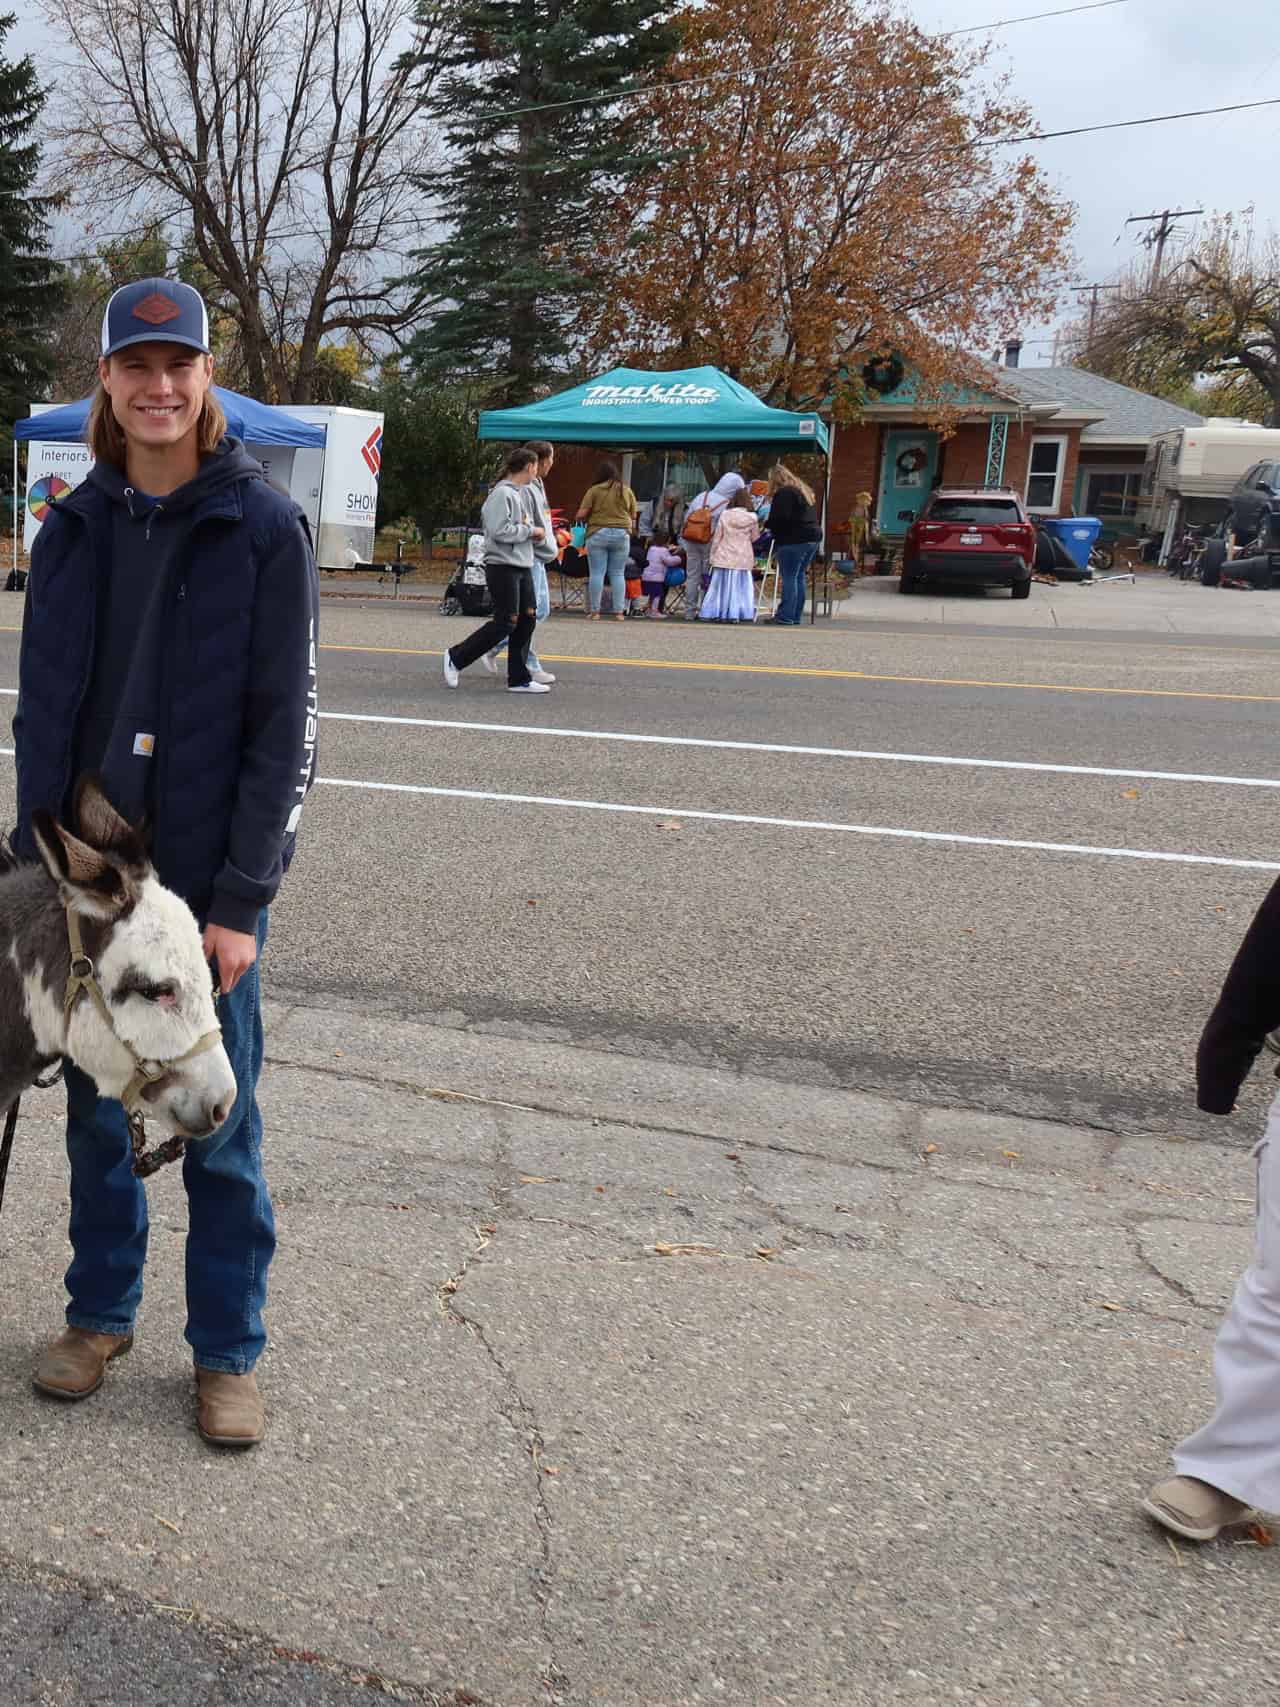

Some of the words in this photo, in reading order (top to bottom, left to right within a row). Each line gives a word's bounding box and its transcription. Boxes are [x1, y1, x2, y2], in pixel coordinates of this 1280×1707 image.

[582, 397, 641, 407] INDUSTRIAL
[644, 396, 683, 405] POWER
[685, 396, 716, 405] TOOLS
[41, 448, 88, 462] Interiors
